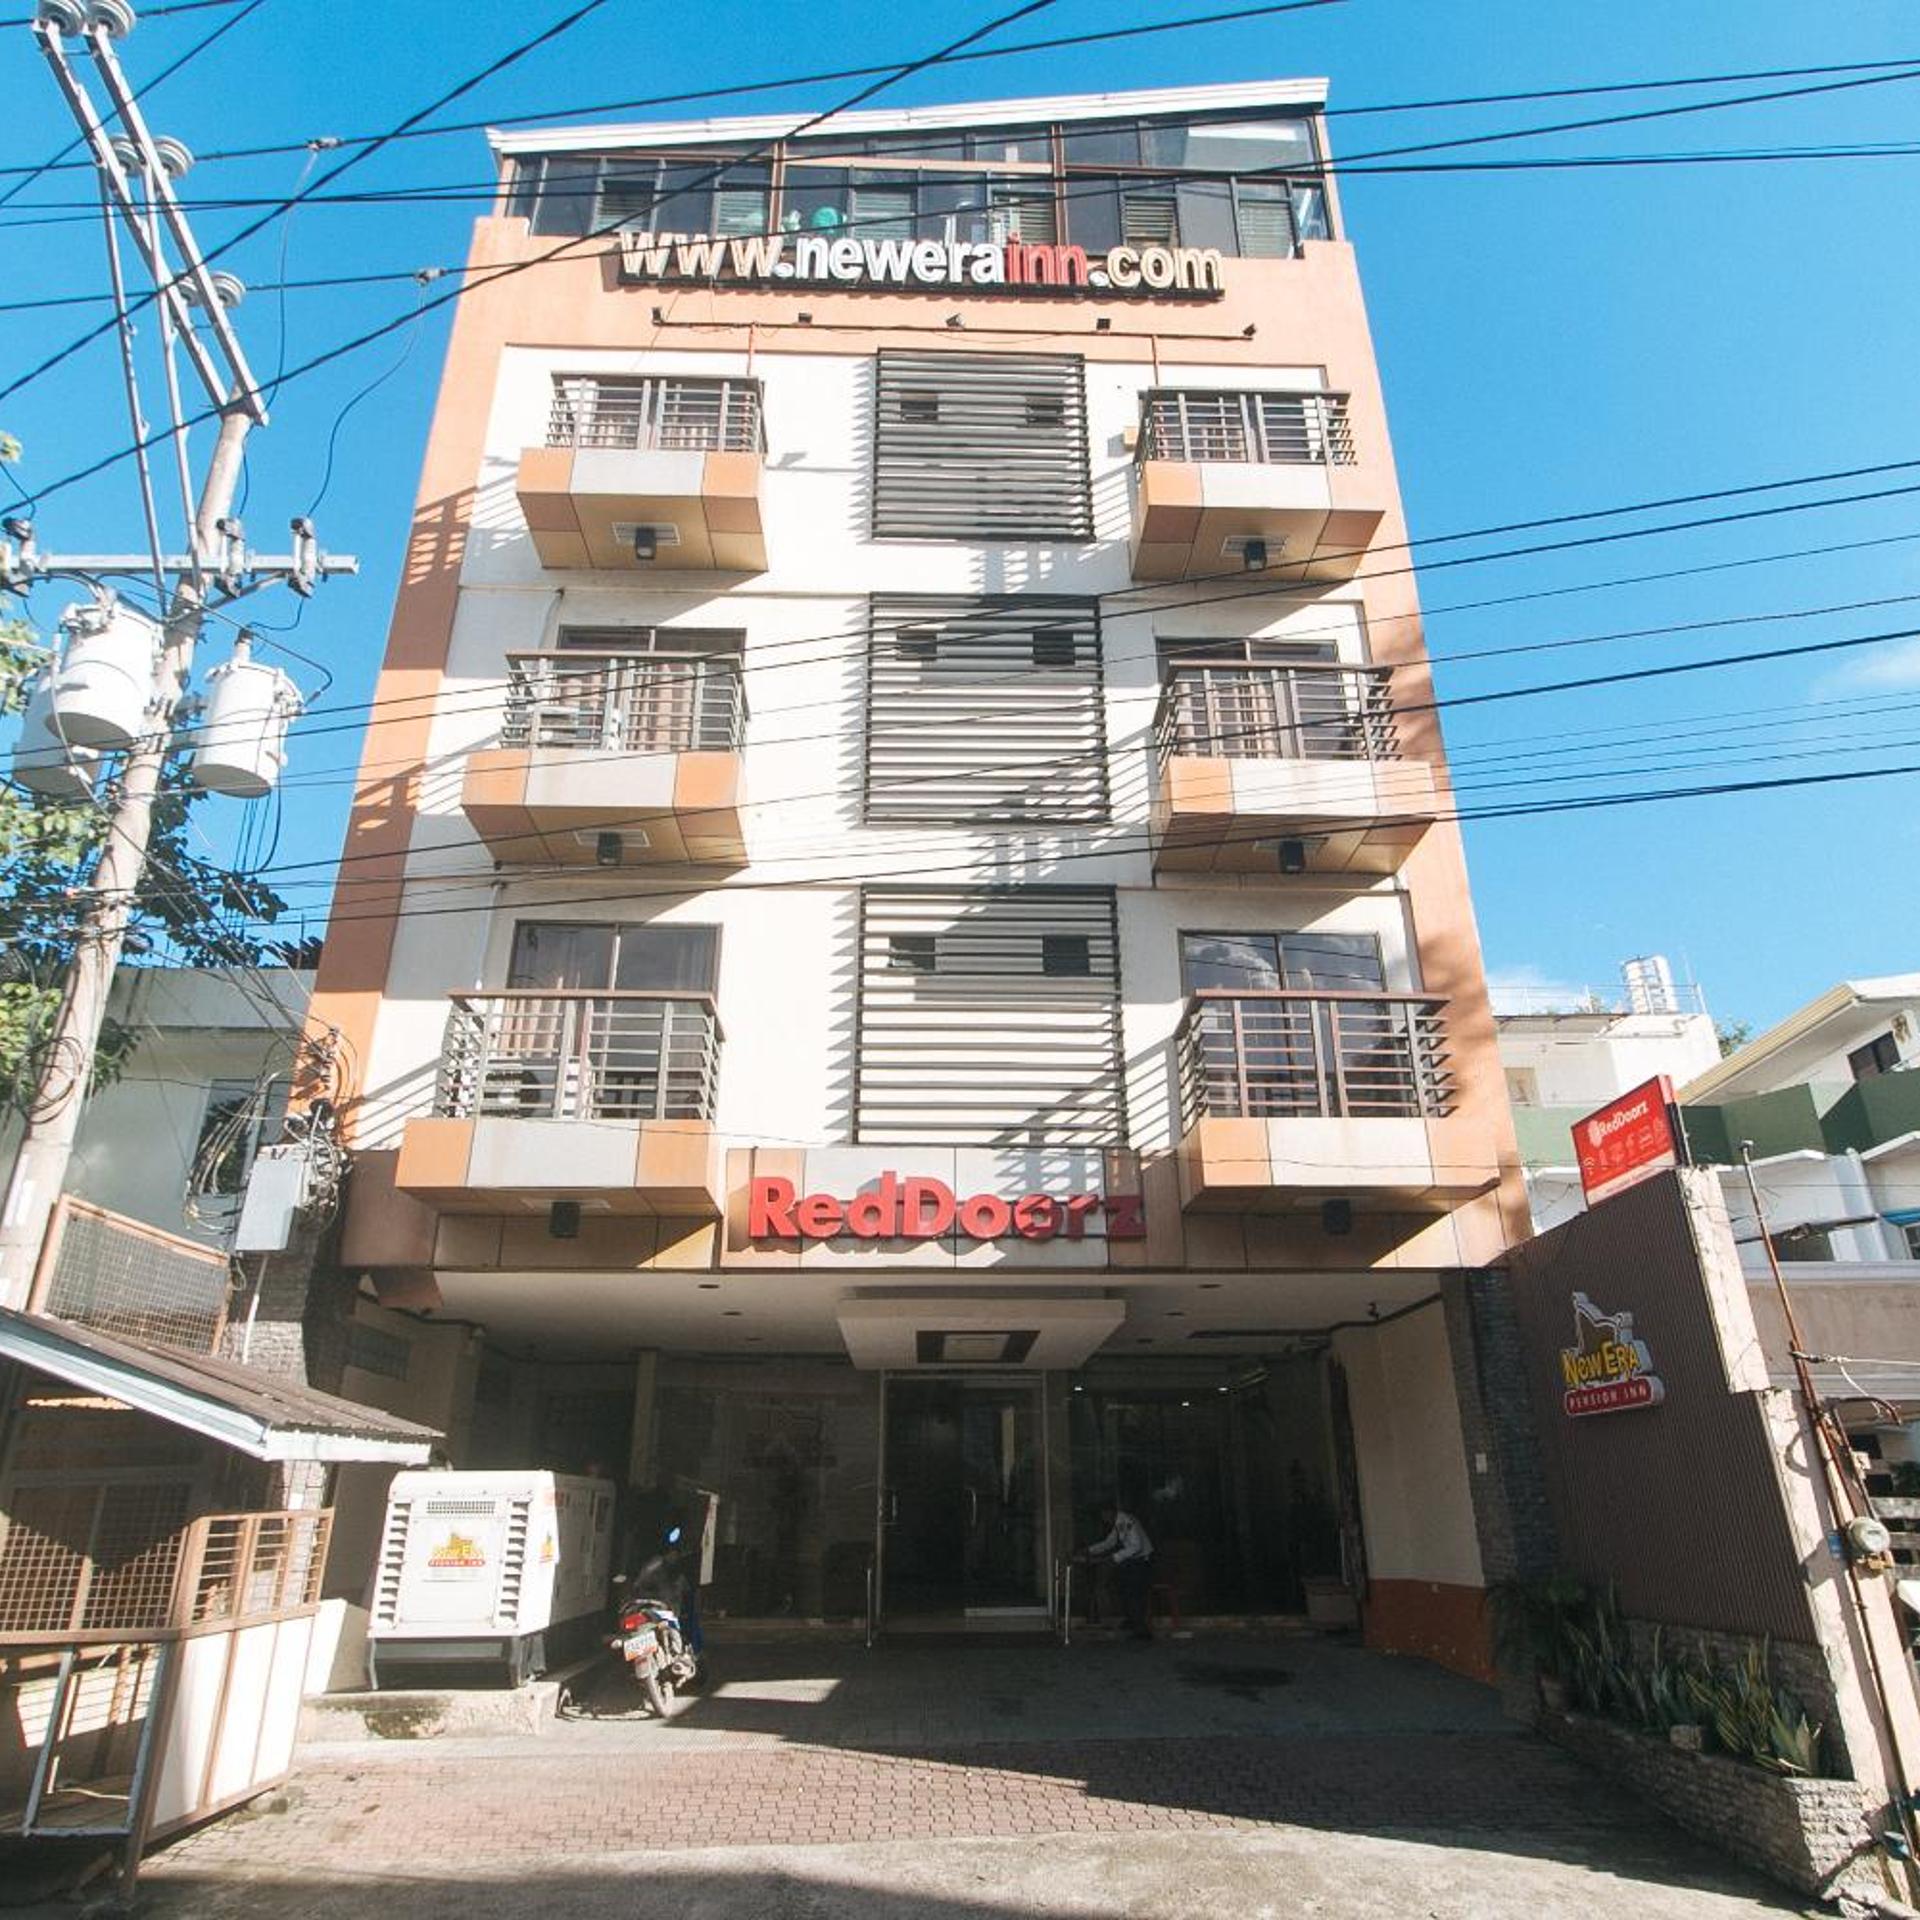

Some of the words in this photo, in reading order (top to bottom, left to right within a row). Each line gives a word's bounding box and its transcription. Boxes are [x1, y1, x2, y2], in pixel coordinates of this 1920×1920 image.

[620, 230, 1225, 291] www.newerainn.com
[1598, 1101, 1649, 1136] RedDoorz
[748, 1171, 1147, 1241] RedDoorz
[1569, 1390, 1618, 1408] PENSION
[1623, 1385, 1648, 1399] INN
